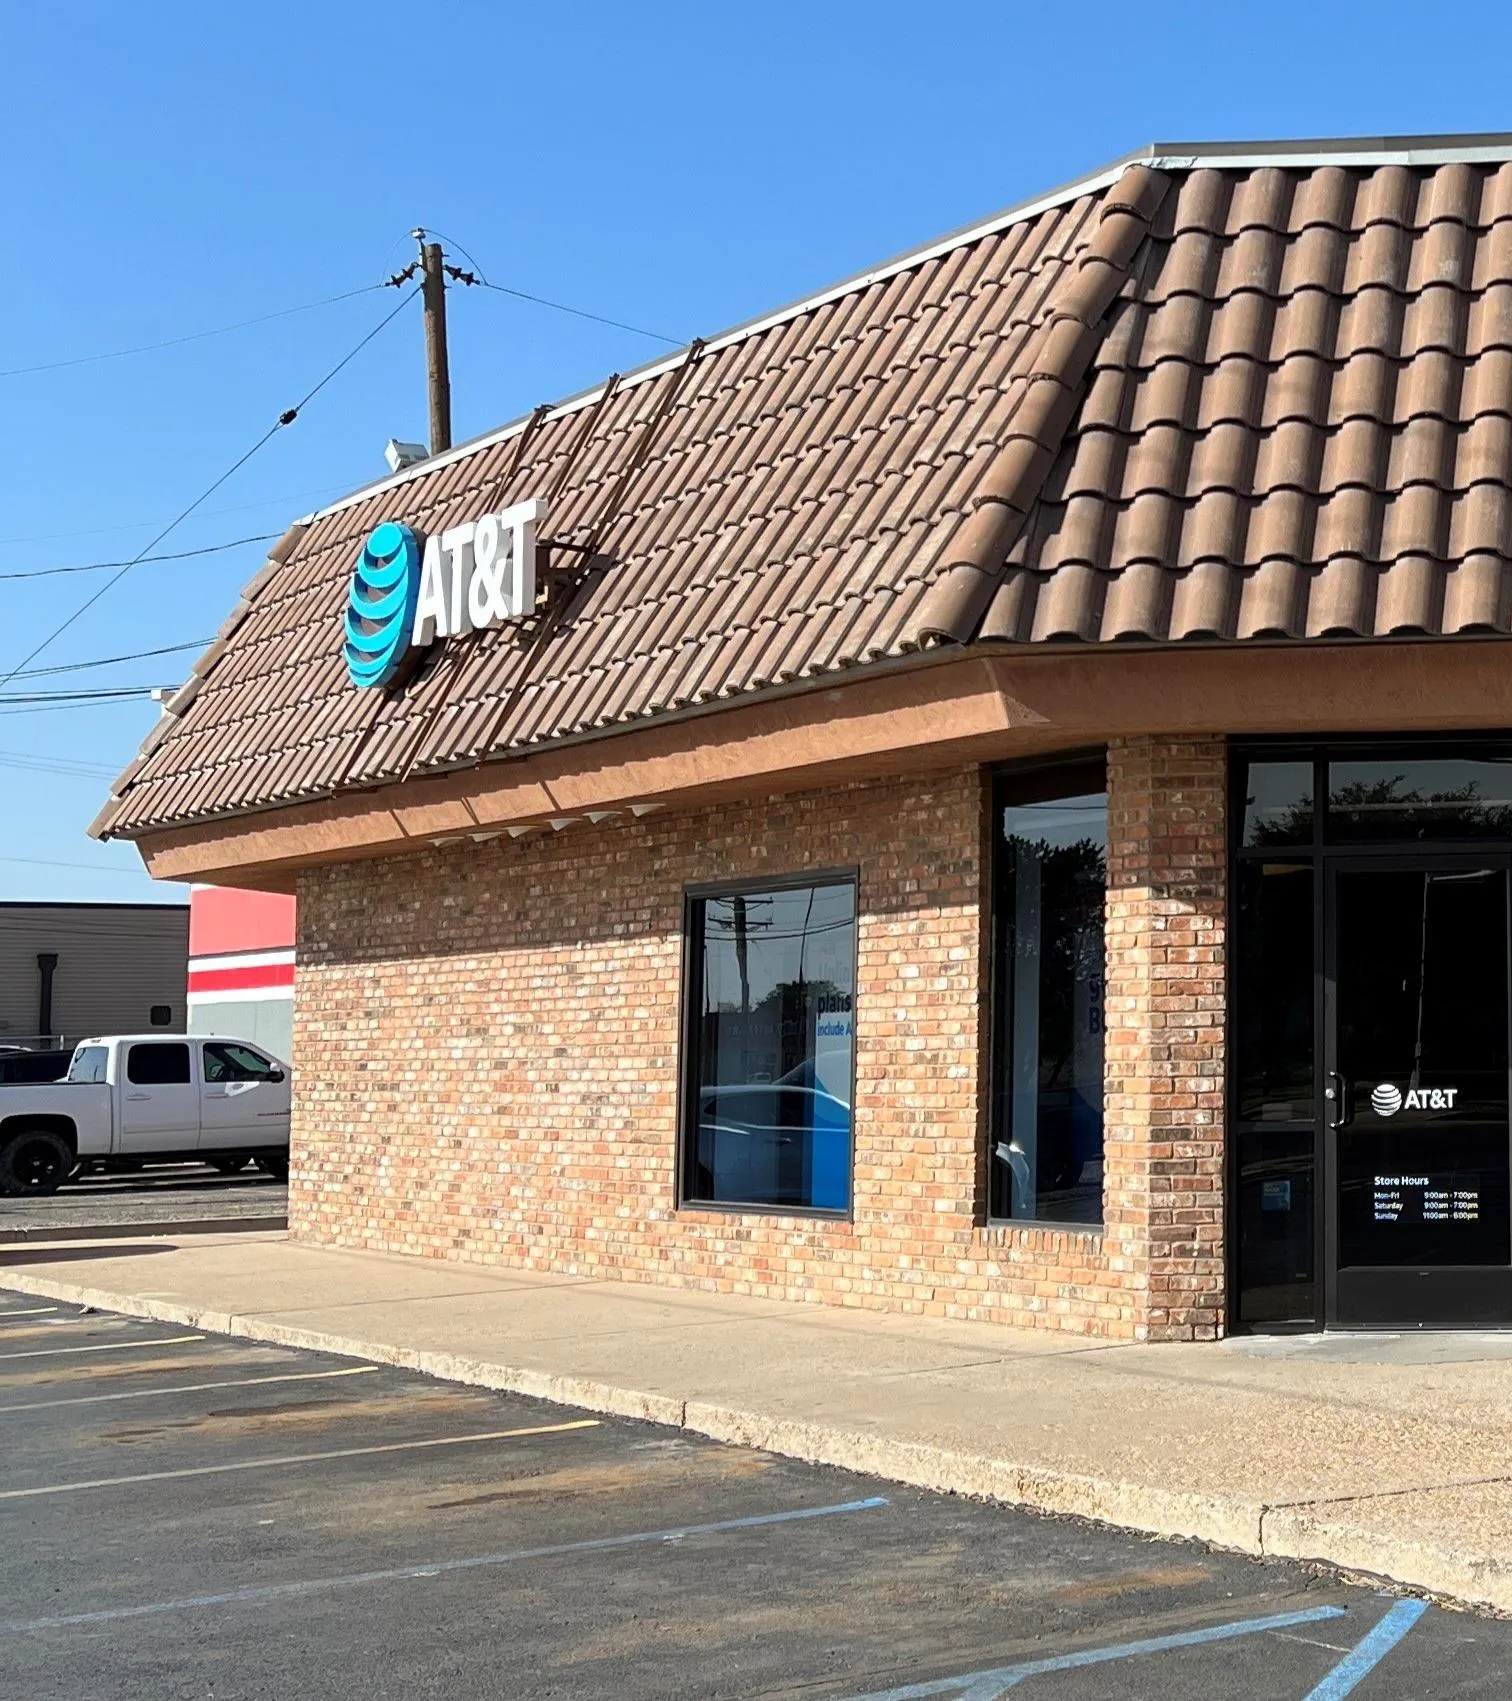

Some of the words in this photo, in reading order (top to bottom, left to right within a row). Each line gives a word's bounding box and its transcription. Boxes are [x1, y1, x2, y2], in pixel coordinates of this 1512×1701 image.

[411, 498, 547, 646] AT&T
[817, 1021, 844, 1036] include
[1404, 1089, 1457, 1109] AT&T
[1374, 1176, 1399, 1185] Store
[1401, 1176, 1429, 1185] Hours
[1374, 1191, 1399, 1199] Mon-Fri
[1374, 1202, 1403, 1211] Saturday
[1374, 1212, 1398, 1221] Sunday
